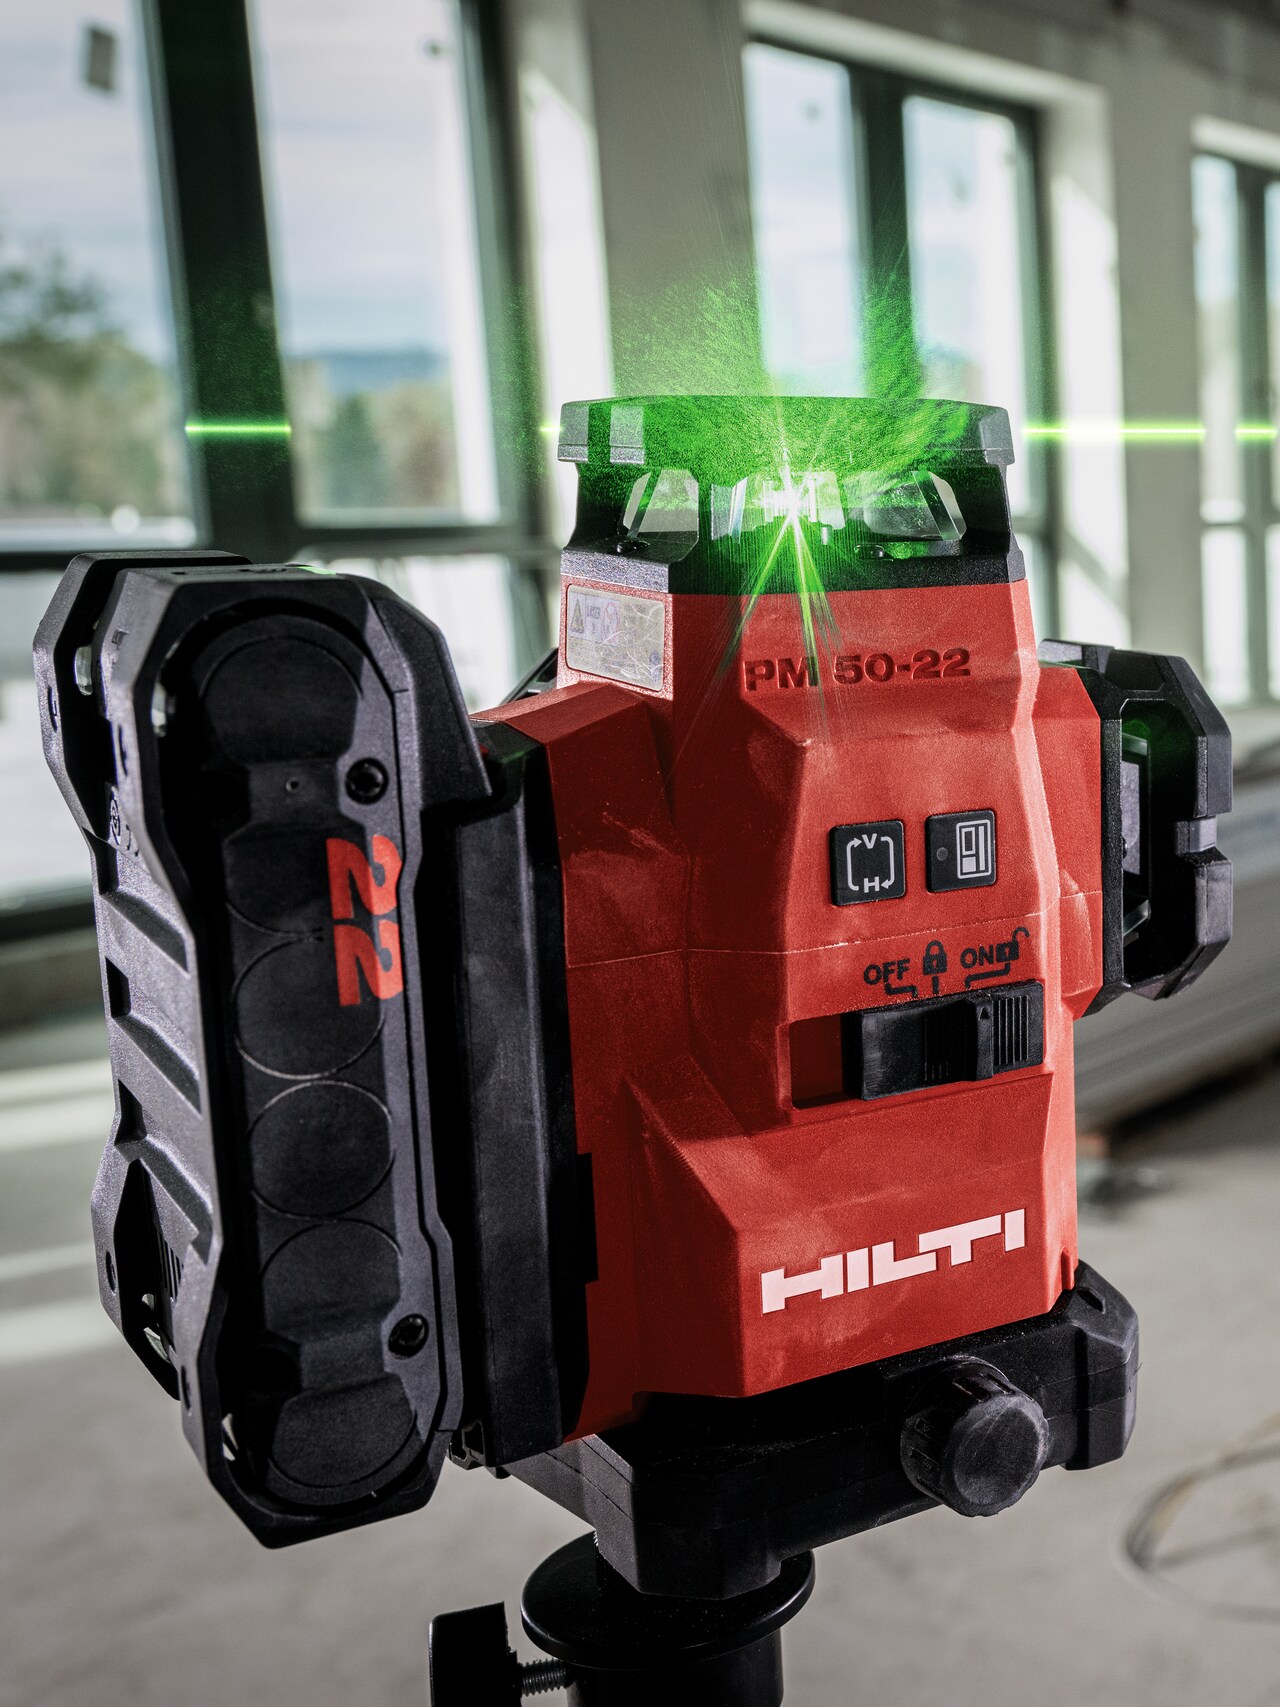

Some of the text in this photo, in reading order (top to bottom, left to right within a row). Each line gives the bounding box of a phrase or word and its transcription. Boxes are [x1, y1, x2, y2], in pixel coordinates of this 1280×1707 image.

[743, 647, 971, 691] PM 50-22
[861, 833, 877, 849] V
[863, 876, 880, 893] H
[325, 834, 404, 1006] 22
[960, 944, 995, 969] ON
[863, 958, 911, 985] OFF
[761, 1208, 1025, 1314] HILTI
